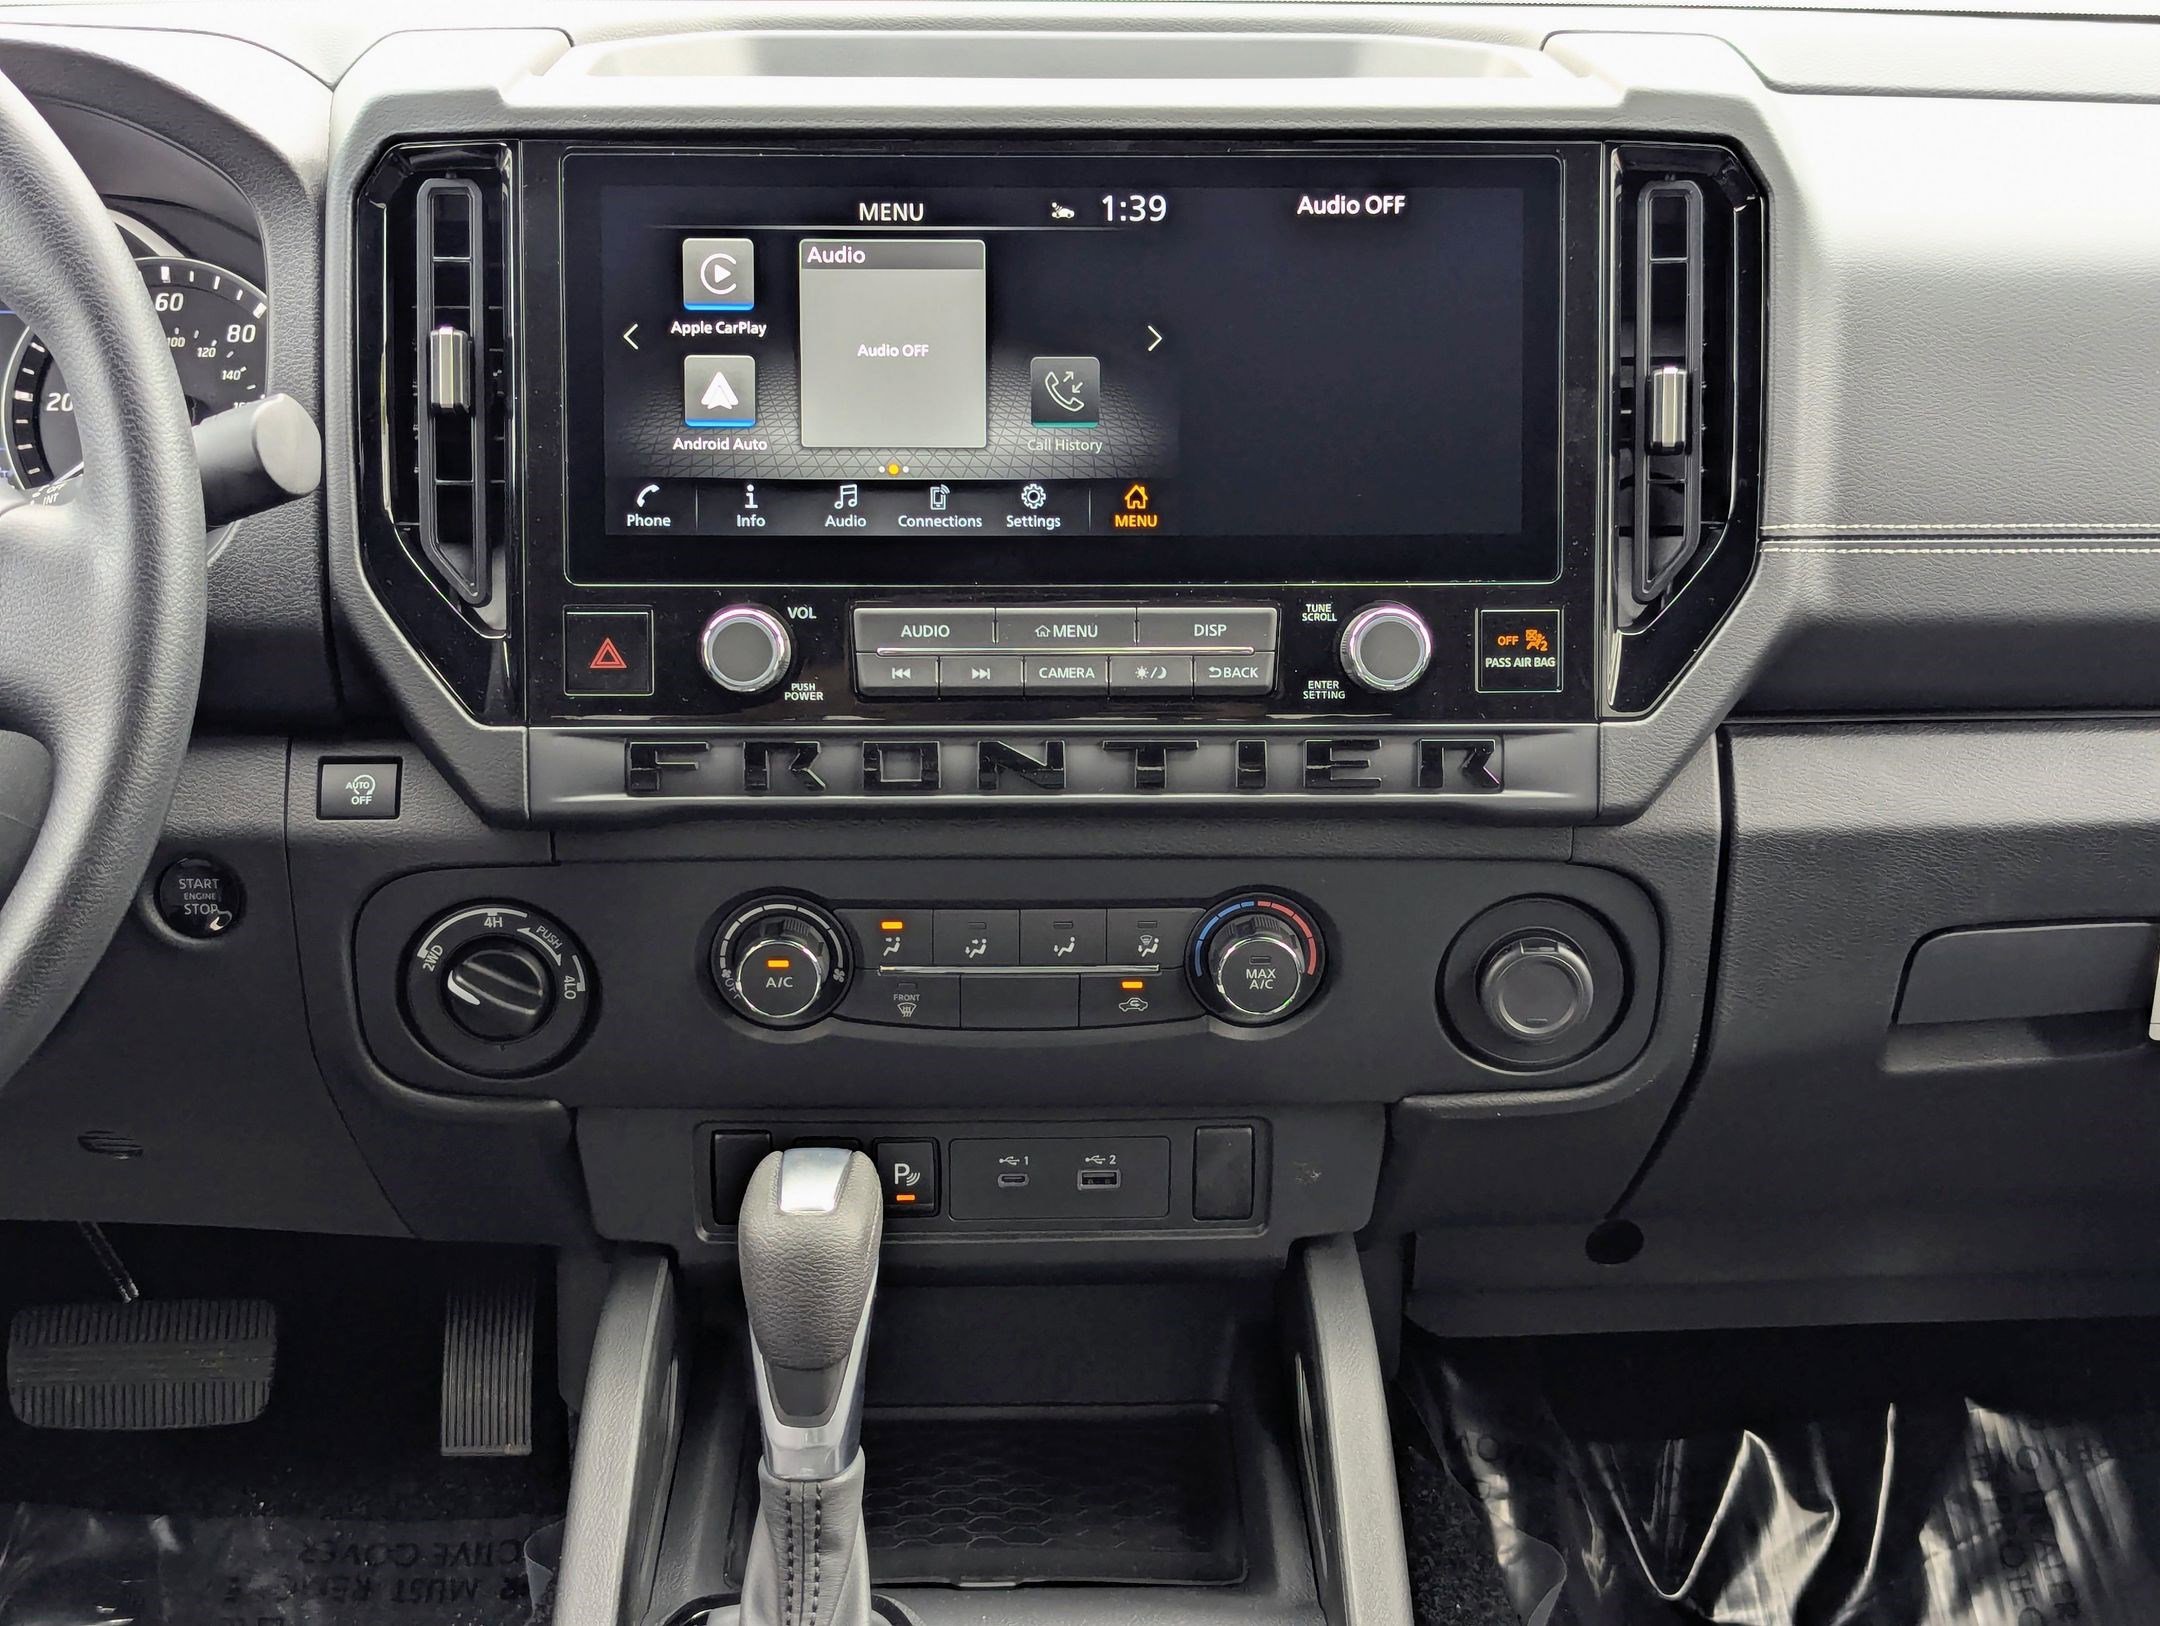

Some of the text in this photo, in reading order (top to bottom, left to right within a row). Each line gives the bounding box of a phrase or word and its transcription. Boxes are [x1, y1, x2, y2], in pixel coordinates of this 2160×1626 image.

[1101, 194, 1167, 222] 1:39
[1297, 194, 1406, 215] Audio OFF
[858, 203, 924, 221] MENU
[806, 246, 866, 264] Audio
[155, 292, 184, 312] 60
[226, 324, 256, 343] 80
[670, 320, 767, 338] Apple CarPlay
[167, 337, 186, 348] 100
[197, 347, 217, 358] 120
[857, 343, 929, 357] Audio OFF
[222, 369, 241, 381] 140
[46, 392, 74, 412] 20
[672, 436, 768, 451] Android Auto
[1026, 436, 1103, 454] Call History
[626, 513, 672, 528] Phone
[736, 513, 766, 528] Info
[824, 513, 867, 528] Audio
[897, 513, 983, 528] Connections
[1006, 513, 1061, 531] Settings
[1114, 514, 1158, 528] MENU
[787, 605, 817, 620] VOL
[1305, 603, 1332, 613] TUNE
[1301, 612, 1338, 622] SCROLL
[900, 624, 950, 638] AUDIO
[1053, 624, 1098, 638] MENU
[1193, 623, 1227, 637] DISP
[1497, 635, 1519, 646] OFF
[1485, 657, 1556, 668] PASS AIR BAG
[1038, 667, 1096, 679] CAMERA
[1222, 667, 1259, 679] BACK
[791, 682, 816, 692] PUSH
[1307, 680, 1340, 690] ENTER
[783, 690, 824, 701] POWER
[1302, 690, 1346, 700] SETTING
[627, 739, 1501, 794] FRONTIER
[345, 781, 370, 790] AUTO
[351, 795, 373, 805] OFF
[178, 878, 220, 890] START
[183, 891, 216, 901] ENGINE
[184, 903, 219, 915] STOP
[483, 916, 503, 928] 4H
[535, 924, 563, 950] PUSH
[422, 943, 444, 973] 2WD
[1245, 968, 1277, 979] MAX
[563, 974, 577, 1000] 4LO
[765, 976, 794, 988] A/C
[1249, 979, 1274, 990] A/C
[893, 993, 921, 1001] FRONT
[1023, 1155, 1030, 1166] 1
[1108, 1154, 1117, 1166] 2
